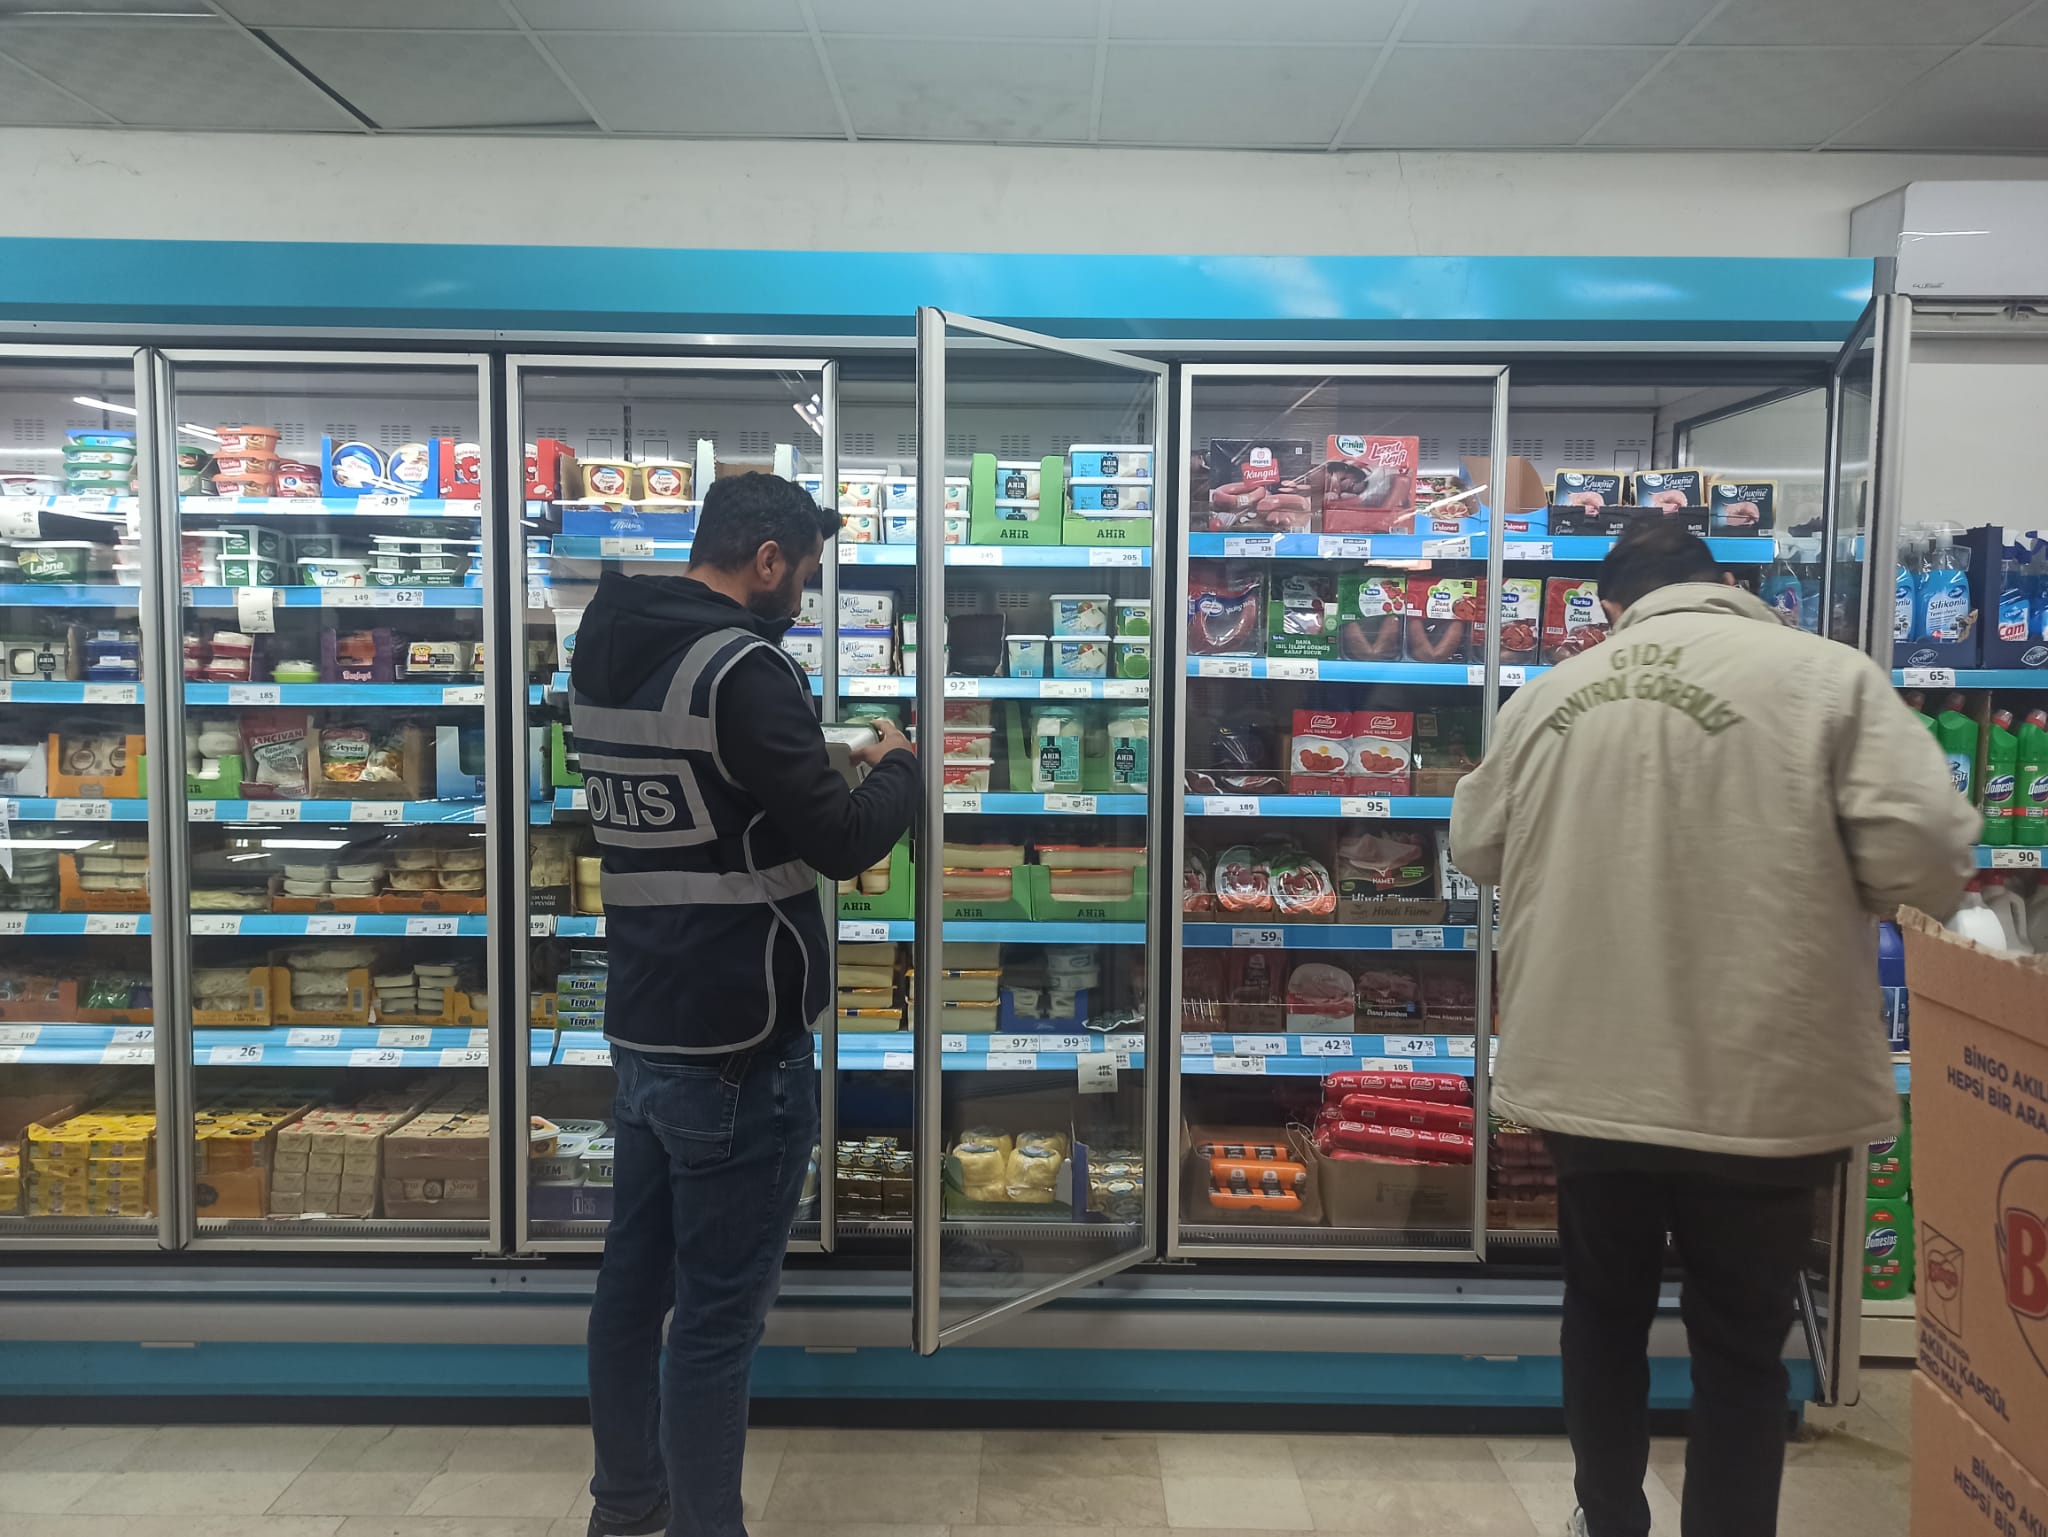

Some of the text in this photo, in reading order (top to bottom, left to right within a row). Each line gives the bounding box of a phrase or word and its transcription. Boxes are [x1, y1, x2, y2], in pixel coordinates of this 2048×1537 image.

[1243, 468, 1278, 480] Kangal
[382, 497, 398, 506] 49
[30, 562, 64, 574] Labne
[396, 592, 412, 601] 62
[1610, 644, 1684, 670] GIDA
[1930, 671, 1944, 680] 65
[950, 681, 965, 690] 92
[2028, 783, 2048, 794] Domes
[193, 808, 208, 816] 239
[1367, 802, 1383, 812] 95
[2018, 852, 2034, 862] 90
[1260, 931, 1276, 941] 59
[135, 1030, 152, 1040] 47
[1012, 1038, 1028, 1047] 97
[1064, 1038, 1079, 1047] 99
[1324, 1040, 1340, 1050] 42
[1408, 1041, 1423, 1050] 47
[240, 1047, 256, 1057] 26
[379, 1051, 396, 1061] 29
[465, 1051, 481, 1061] 59
[1964, 1044, 2048, 1104] BİNGO AKIL
[1947, 1065, 2048, 1136] HEPSİ BİR ARA
[1865, 1235, 1897, 1248] Domestos
[1972, 1456, 2015, 1512] BİNGO
[1954, 1464, 1991, 1519] HEPSİ
